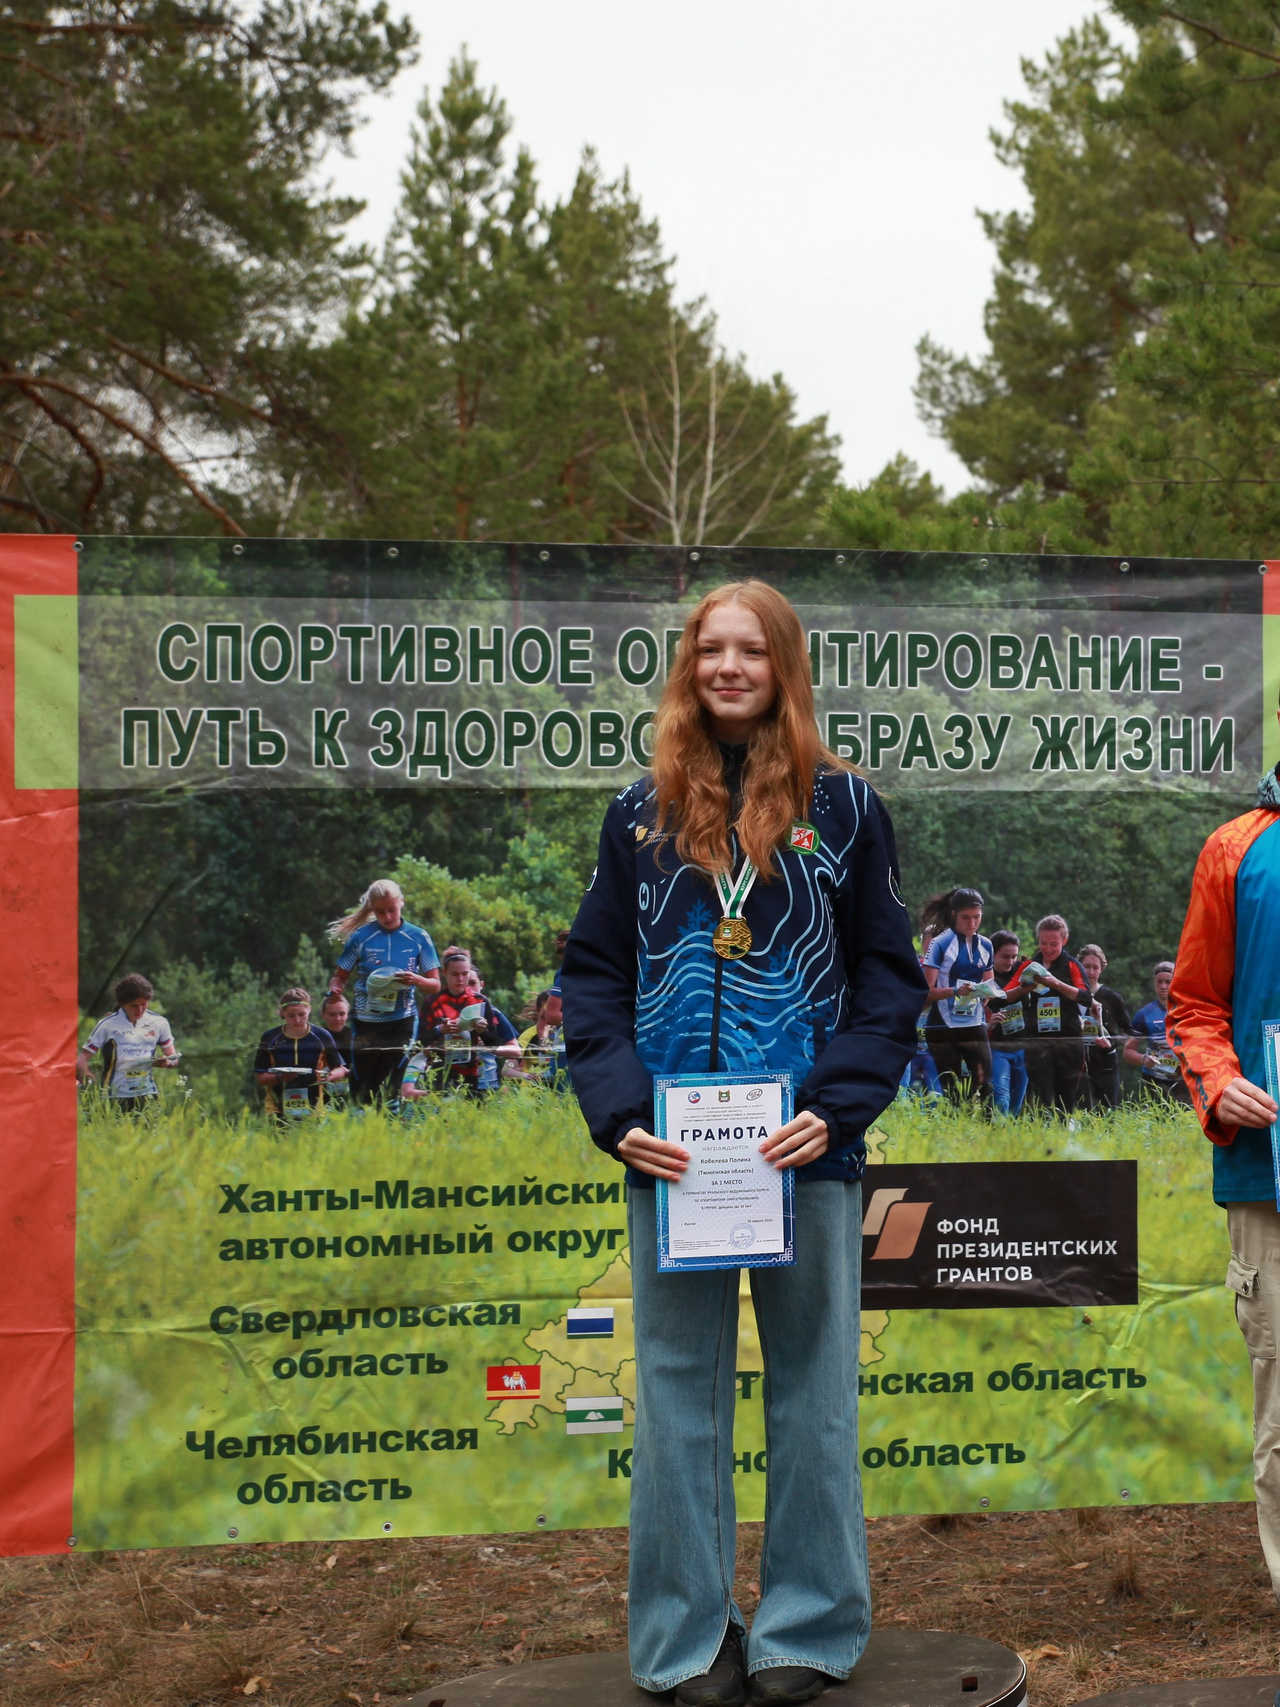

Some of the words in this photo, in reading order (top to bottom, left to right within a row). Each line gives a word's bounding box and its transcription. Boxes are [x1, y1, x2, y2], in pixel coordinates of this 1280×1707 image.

[158, 622, 594, 686] СПОРТИВНОЕ
[617, 627, 1182, 693] ОТИРОВАНИЕ
[121, 707, 288, 769] ПУТЬ
[312, 708, 349, 768] К
[370, 708, 660, 779] ЗДОРОВО
[820, 711, 1012, 771] БРАЗУ
[1031, 715, 1235, 773] ЖИЗНИ
[1039, 1009, 1058, 1017] 4501
[680, 1125, 769, 1142] ГРАМОТА
[219, 1224, 494, 1262] автономный
[506, 1228, 625, 1259] округ
[936, 1217, 999, 1237] ФОНД
[936, 1239, 1118, 1260] ПРЕЗИДЕНТСКИХ
[936, 1265, 1034, 1284] ГРАНТОВ
[209, 1302, 521, 1340] Свердловская
[272, 1351, 449, 1380] область
[986, 1361, 1148, 1393] область
[185, 1425, 479, 1460] Челябинская
[862, 1437, 1027, 1469] область
[236, 1472, 413, 1505] область
